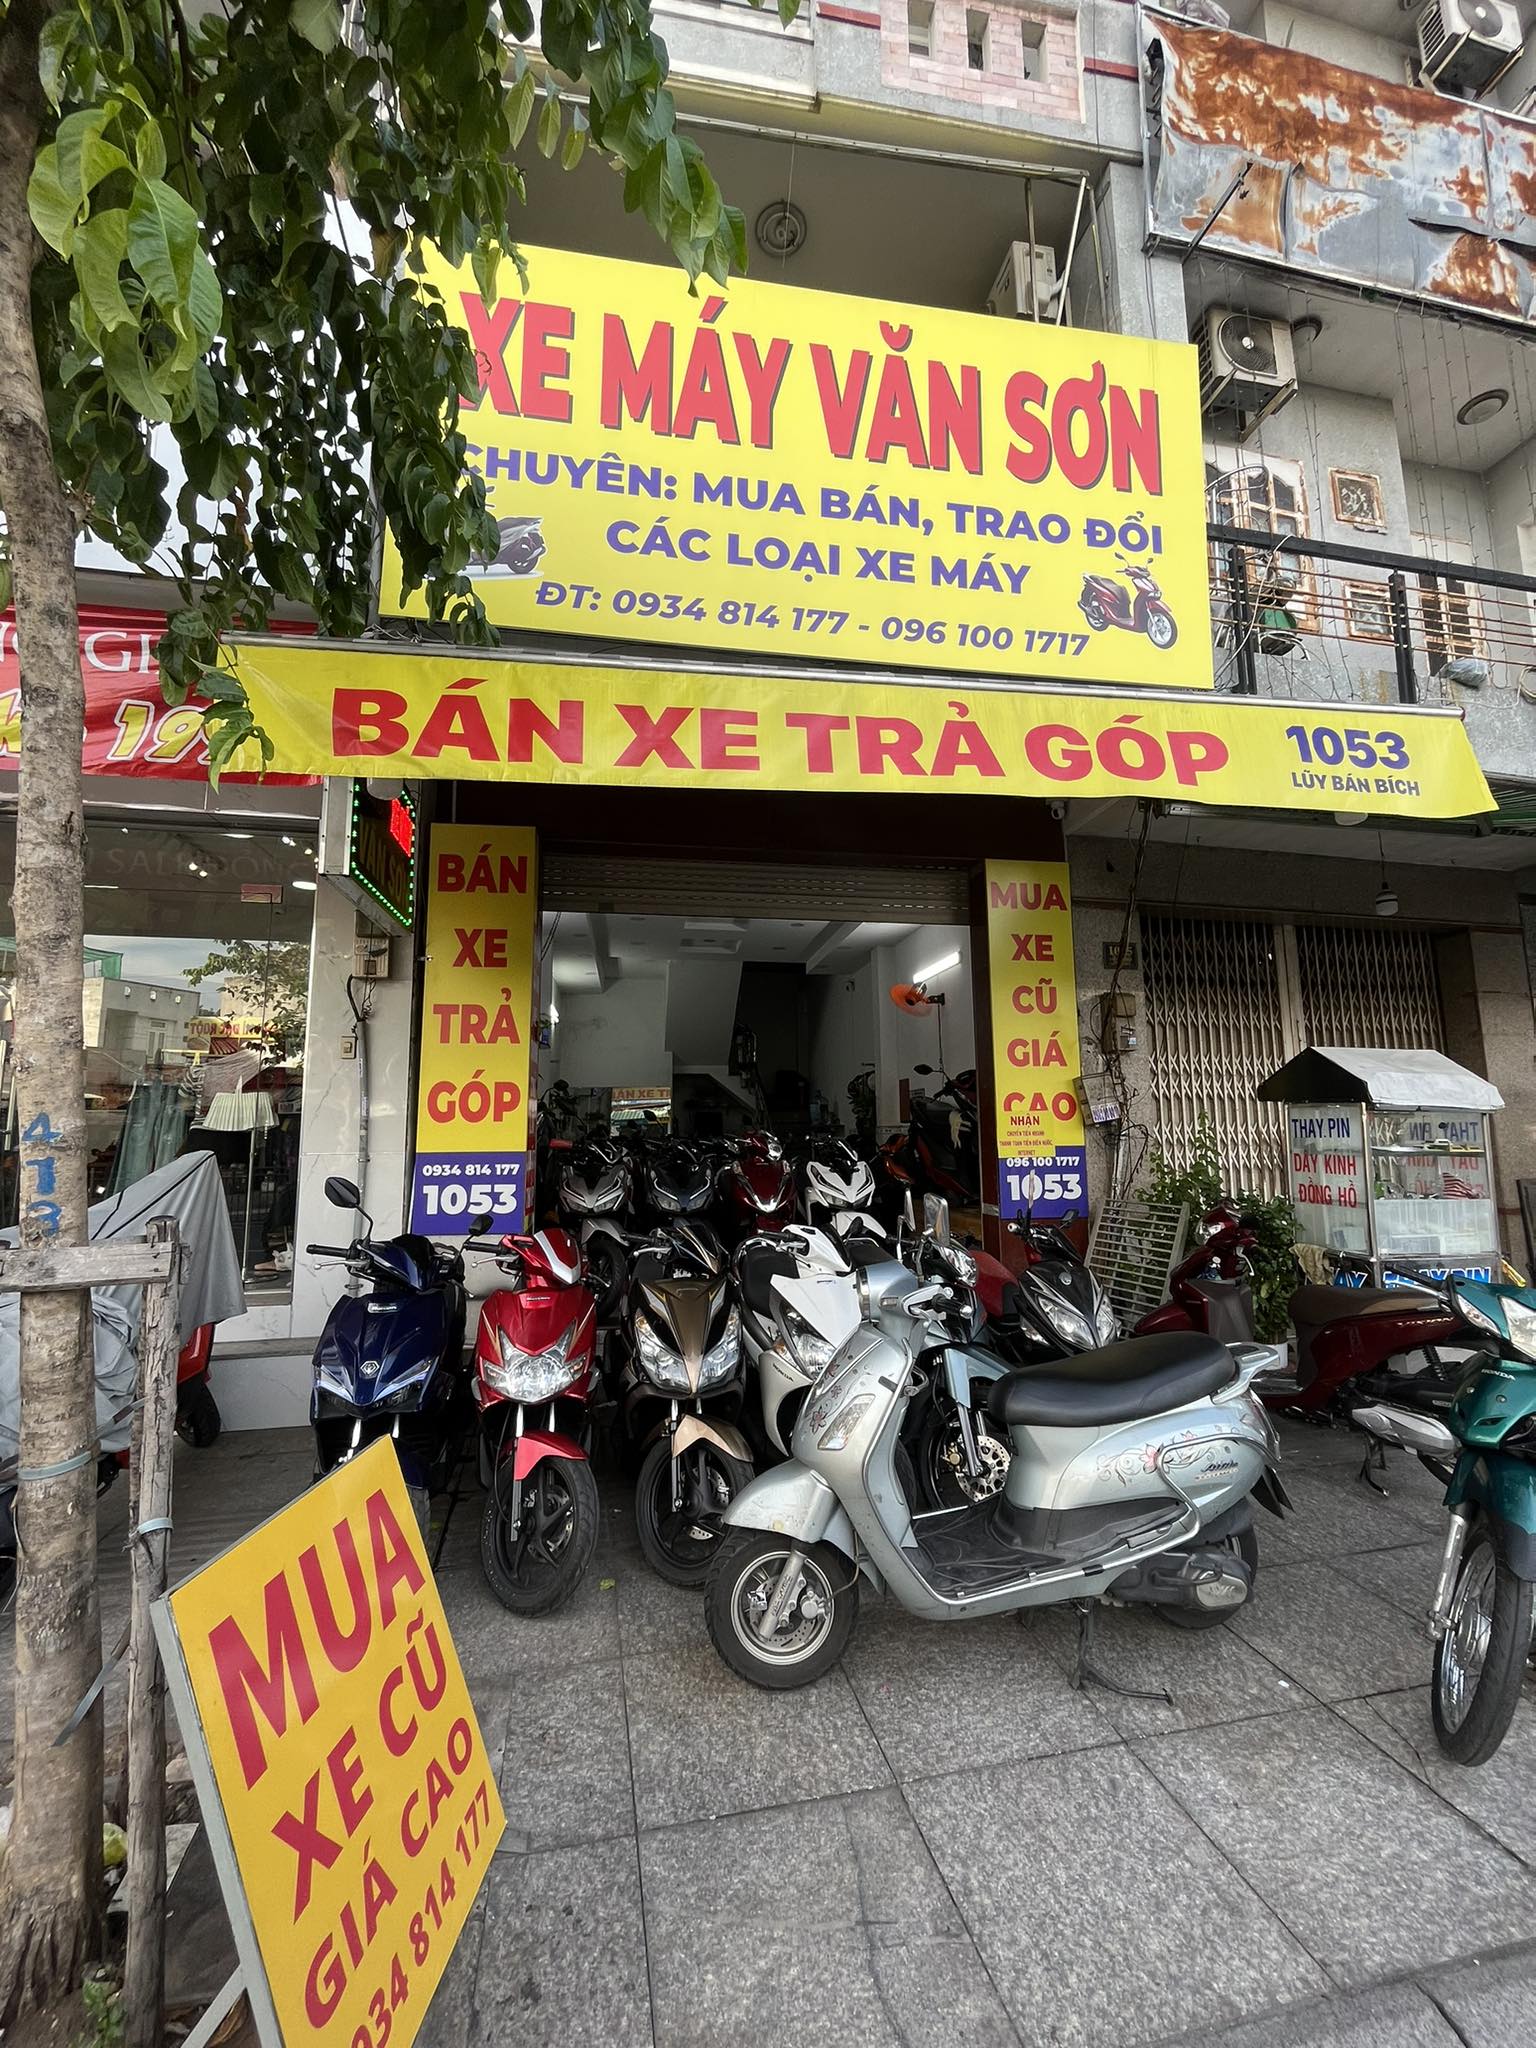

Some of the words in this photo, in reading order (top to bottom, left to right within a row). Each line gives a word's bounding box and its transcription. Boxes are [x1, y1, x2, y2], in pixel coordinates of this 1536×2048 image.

[459, 291, 575, 424] XE
[600, 297, 793, 449] MÁY
[809, 322, 986, 475] VĂN
[1005, 360, 1163, 495] SƠN
[461, 443, 678, 500] CHUYÊN:
[694, 473, 803, 515] MUA
[821, 488, 932, 535] BÁN,
[948, 503, 1069, 545] TRAO
[1085, 513, 1163, 555] ĐỔI
[606, 520, 708, 561] CÁC
[727, 534, 840, 577] LOẠI
[856, 548, 916, 584] XE
[931, 555, 1031, 594] MÁY
[535, 582, 600, 612] ĐT:
[612, 588, 706, 622] 0934
[717, 599, 779, 630] 814
[792, 607, 848, 635] 177
[881, 616, 947, 644] 096
[957, 624, 1014, 650] 100
[1024, 630, 1090, 656] 1717
[107, 699, 210, 764] 19
[332, 677, 584, 763] BÁN
[613, 704, 760, 771] XE
[786, 698, 1006, 779] TRẢ
[1023, 714, 1230, 788] GÓP
[1285, 725, 1410, 770] 1053
[1291, 769, 1327, 789] LŨY
[1332, 773, 1371, 793] BÁN
[1374, 775, 1420, 796] BÍCH
[437, 844, 528, 894] BÁN
[990, 881, 1067, 911] MUA
[453, 928, 508, 968] XE
[1011, 933, 1054, 962] XE
[433, 988, 521, 1044] TRẢ
[1012, 977, 1058, 1015] CŨ
[1007, 1030, 1068, 1068] GIÁ
[427, 1069, 521, 1124] GÓP
[1003, 1091, 1077, 1121] CAO
[1010, 1112, 1040, 1128] NHẬN
[1328, 1117, 1350, 1138] PIN
[422, 1164, 462, 1177] 0934
[464, 1164, 492, 1176] 814
[494, 1164, 520, 1176] 177
[1006, 1157, 1030, 1167] 096
[1032, 1157, 1053, 1167] 100
[1055, 1156, 1080, 1166] 1717
[423, 1183, 517, 1215] 1053
[1006, 1173, 1082, 1201] 1053
[1298, 1176, 1333, 1205] ĐỒNG
[1337, 1180, 1357, 1208] HỒ
[1481, 1368, 1516, 1381] HONDA
[208, 1488, 427, 1791] MUA
[271, 1725, 374, 1925] XE
[380, 1608, 447, 1757] CŨ
[304, 1839, 398, 2030] GIÁ
[400, 1716, 473, 1858] CAO
[409, 1857, 456, 1968] 814
[456, 1780, 491, 1867] 177
